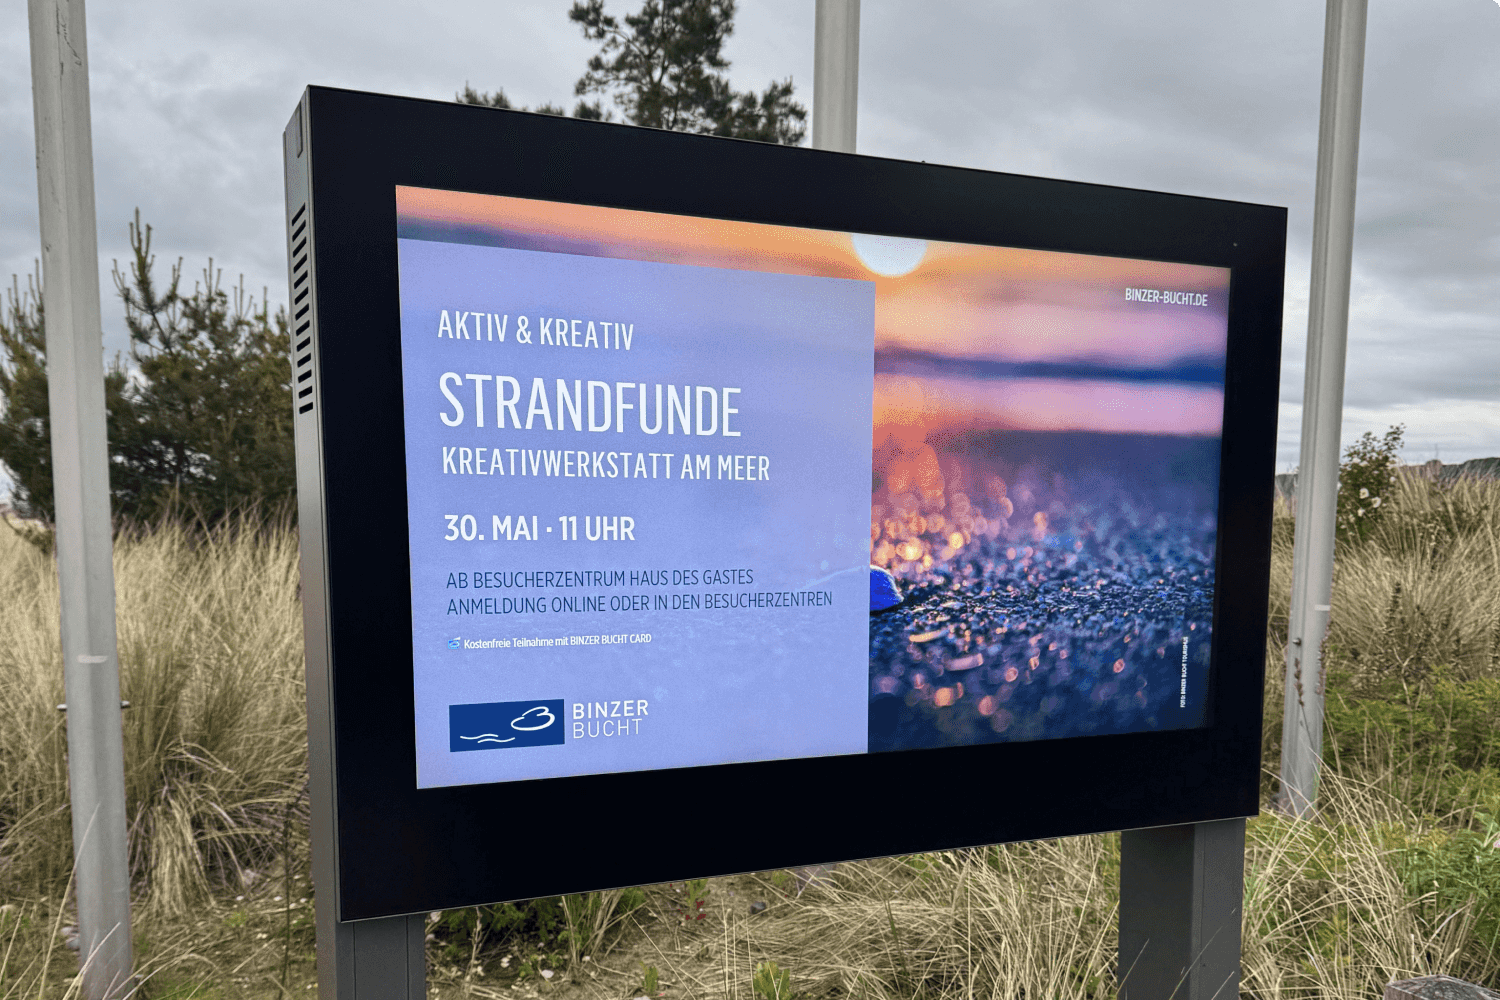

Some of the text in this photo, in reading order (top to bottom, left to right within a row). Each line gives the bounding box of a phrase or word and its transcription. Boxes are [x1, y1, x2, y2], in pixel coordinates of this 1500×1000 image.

[1125, 287, 1208, 307] BINZER-BUCHT.DE
[438, 309, 634, 350] AKTIV & KREATIV
[439, 372, 741, 437] STRANDFUNDE
[442, 447, 770, 481] KREATIVWERKSTATT AM MEER
[444, 514, 485, 541] 30.
[492, 515, 538, 541] MAI
[558, 515, 578, 540] 11
[585, 516, 635, 541] UHR
[446, 569, 754, 589] AB BESUCHERZENTRUM HAUS DES GASTES
[447, 591, 833, 616] ANMELDUNG ONLINE ODER IN DEN BESUCHERZENTREN
[464, 634, 651, 649] Kostenfreie Teilnahme mit BINZER BUCHT CARD
[573, 699, 649, 720] BINZER
[573, 718, 644, 739] BUCHT
